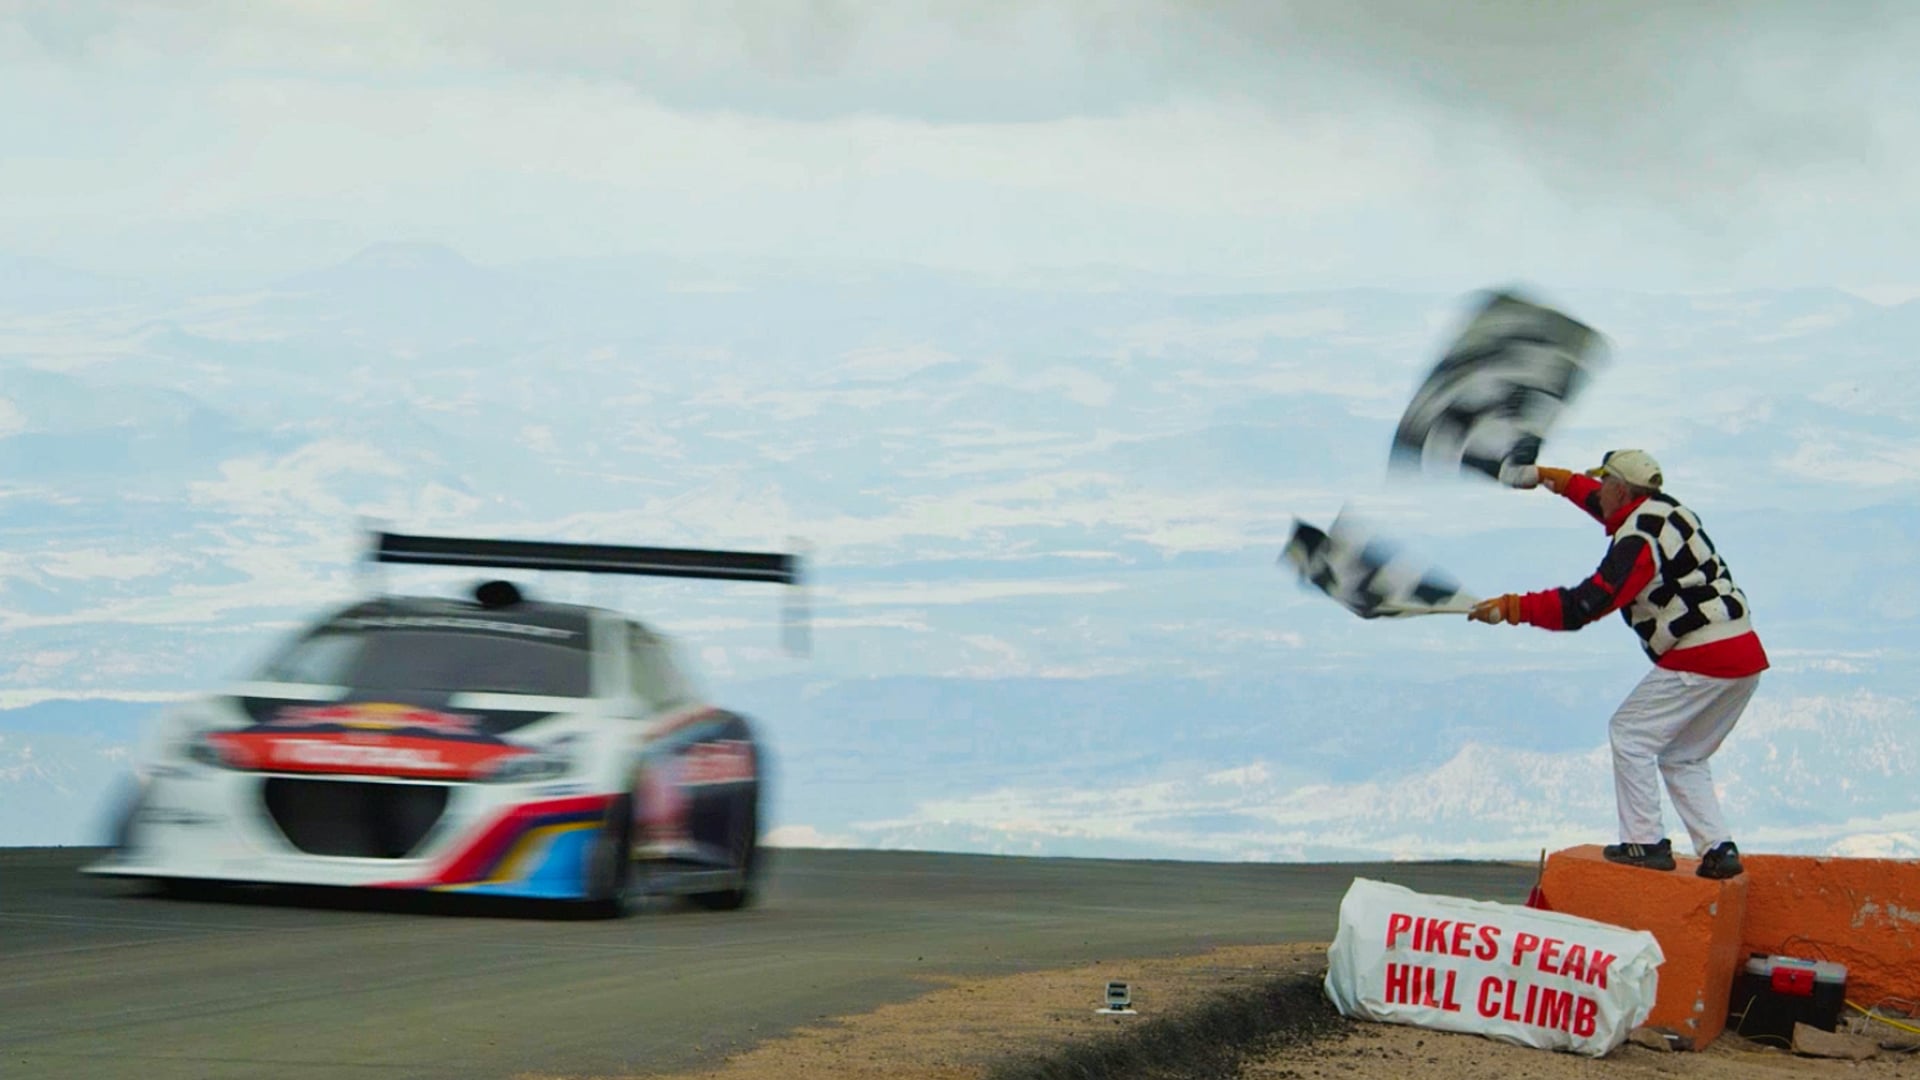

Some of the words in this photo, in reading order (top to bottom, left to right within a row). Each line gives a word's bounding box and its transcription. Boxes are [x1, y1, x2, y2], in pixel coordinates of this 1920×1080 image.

[1386, 913, 1501, 961] PIKES
[1511, 932, 1616, 989] PEAK
[1385, 963, 1461, 1012] HILL
[1477, 976, 1598, 1038] CLIMB
